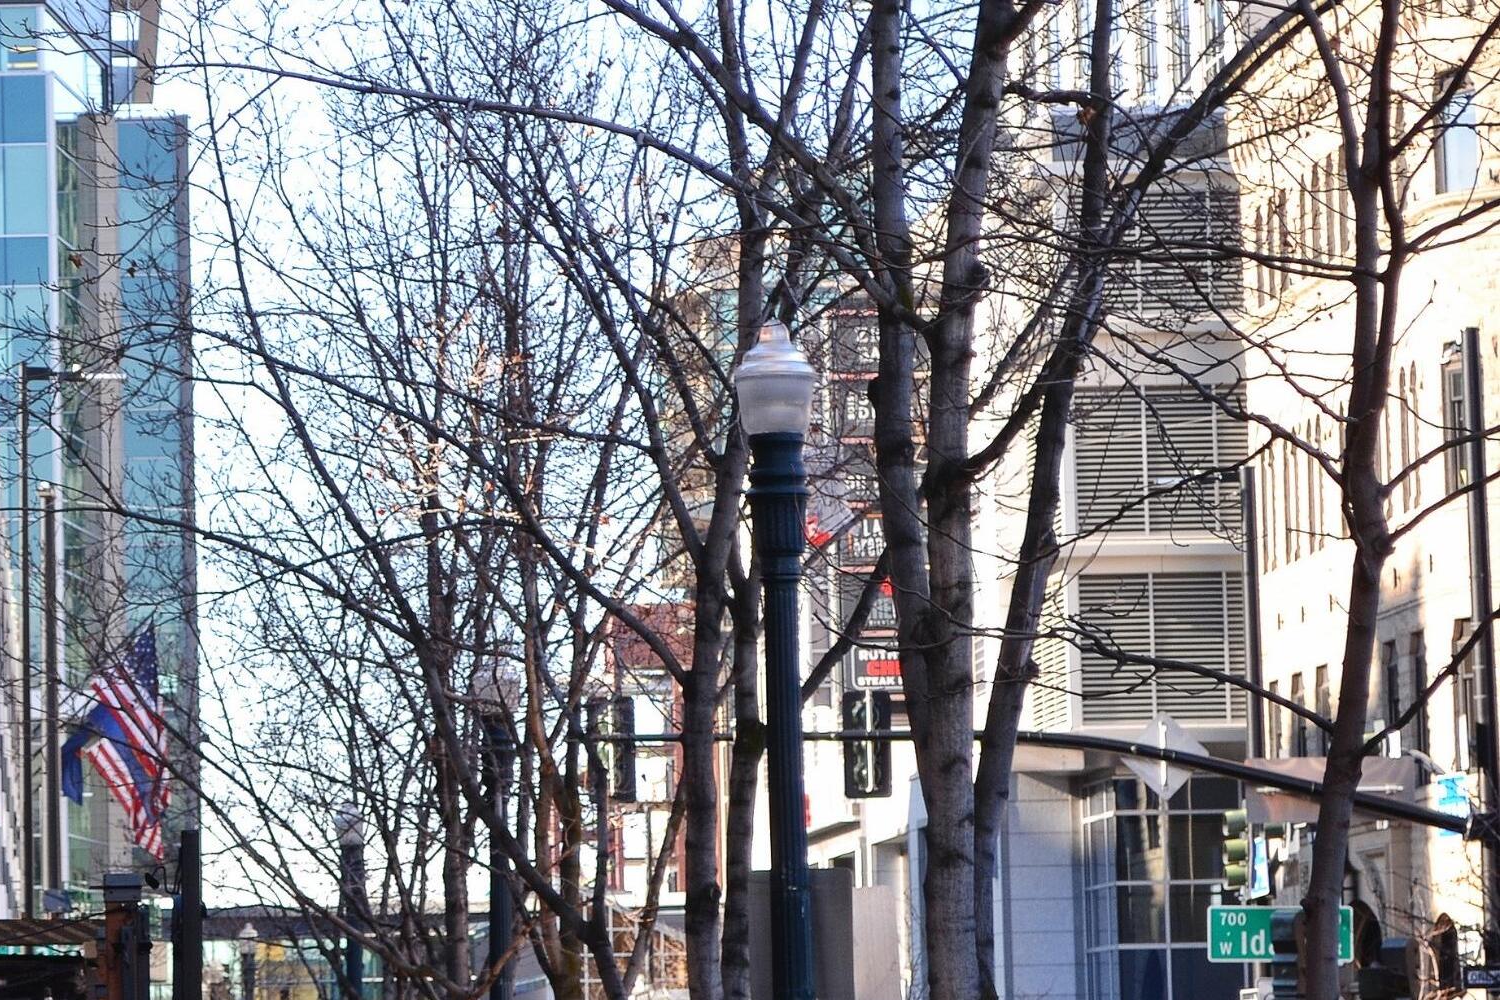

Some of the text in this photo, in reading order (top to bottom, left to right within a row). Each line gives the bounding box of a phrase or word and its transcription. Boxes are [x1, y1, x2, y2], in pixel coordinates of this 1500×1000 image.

[857, 676, 895, 686] STEAK
[1219, 912, 1247, 926] 700
[1219, 941, 1233, 956] W
